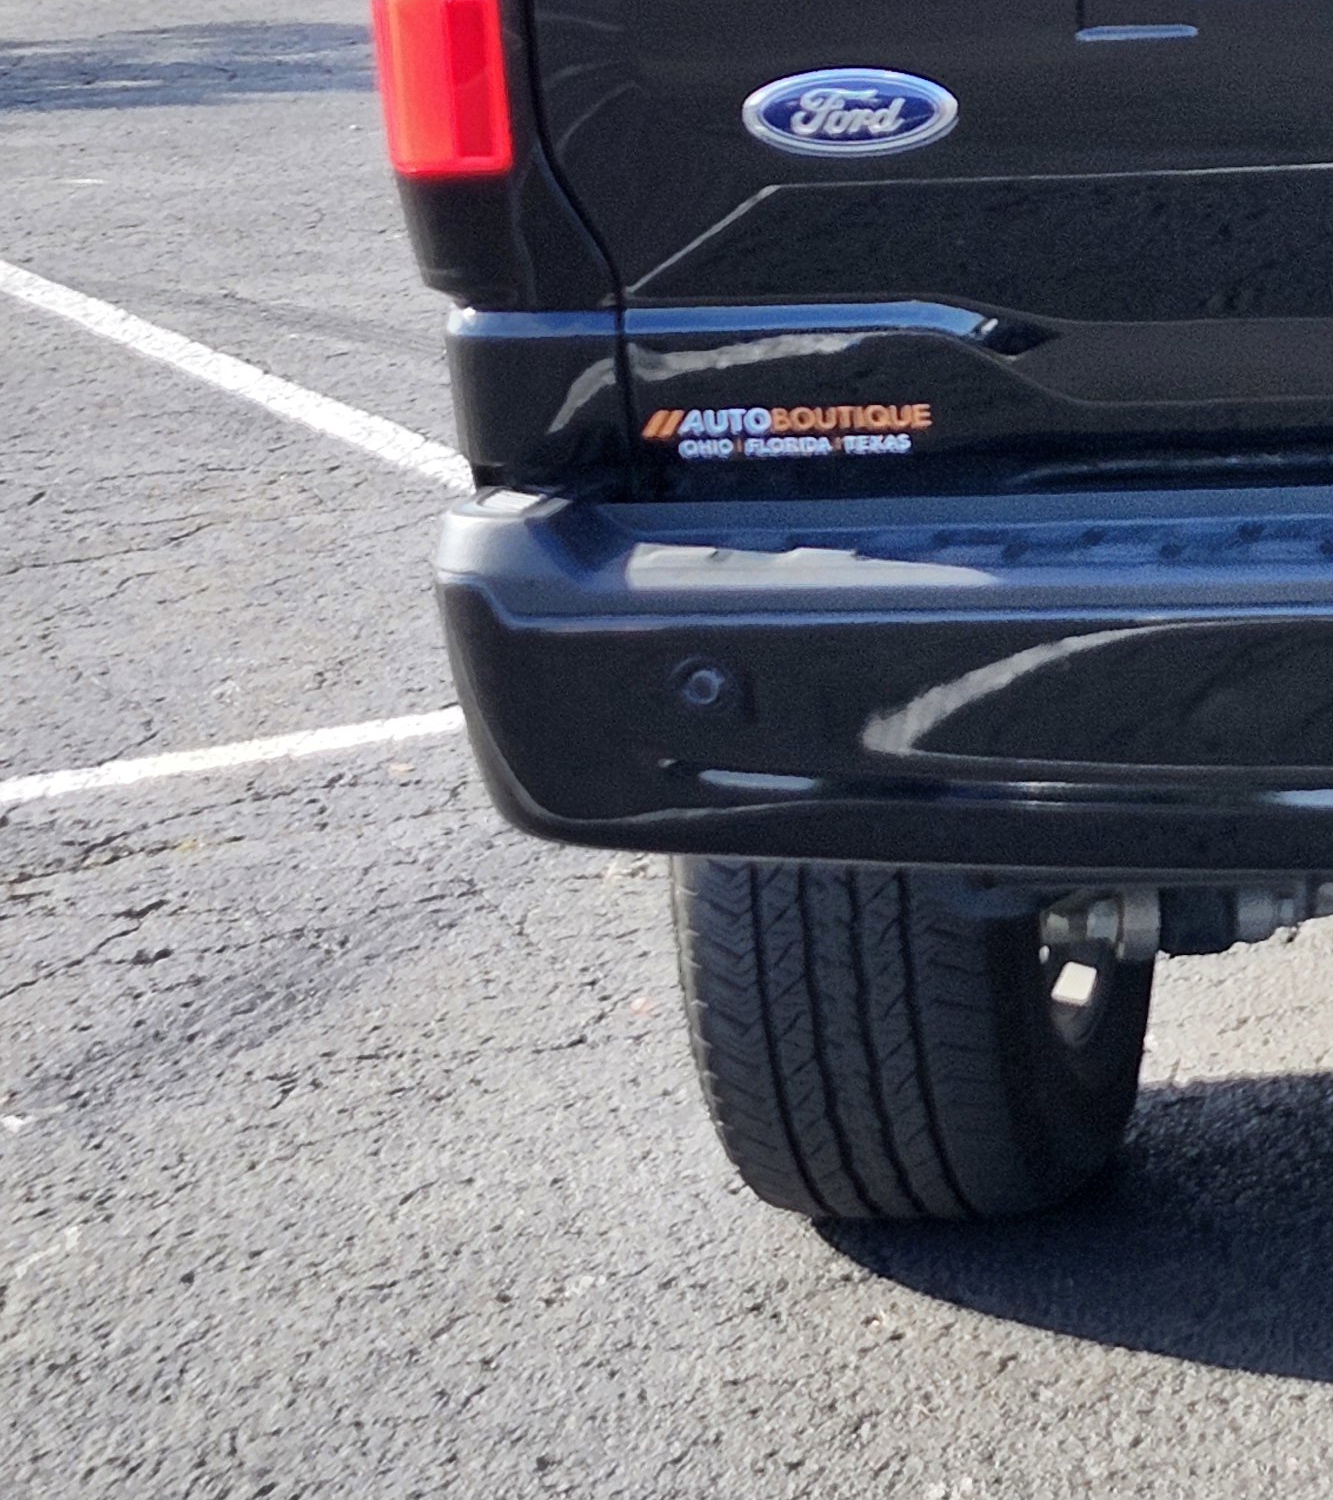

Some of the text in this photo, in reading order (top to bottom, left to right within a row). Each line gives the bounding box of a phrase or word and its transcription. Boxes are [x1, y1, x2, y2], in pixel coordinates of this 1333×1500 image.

[789, 87, 907, 136] Ford
[677, 404, 934, 436] AUTOBOUTIQUE
[678, 433, 912, 460] OHIO FLORIDA TEXAS
